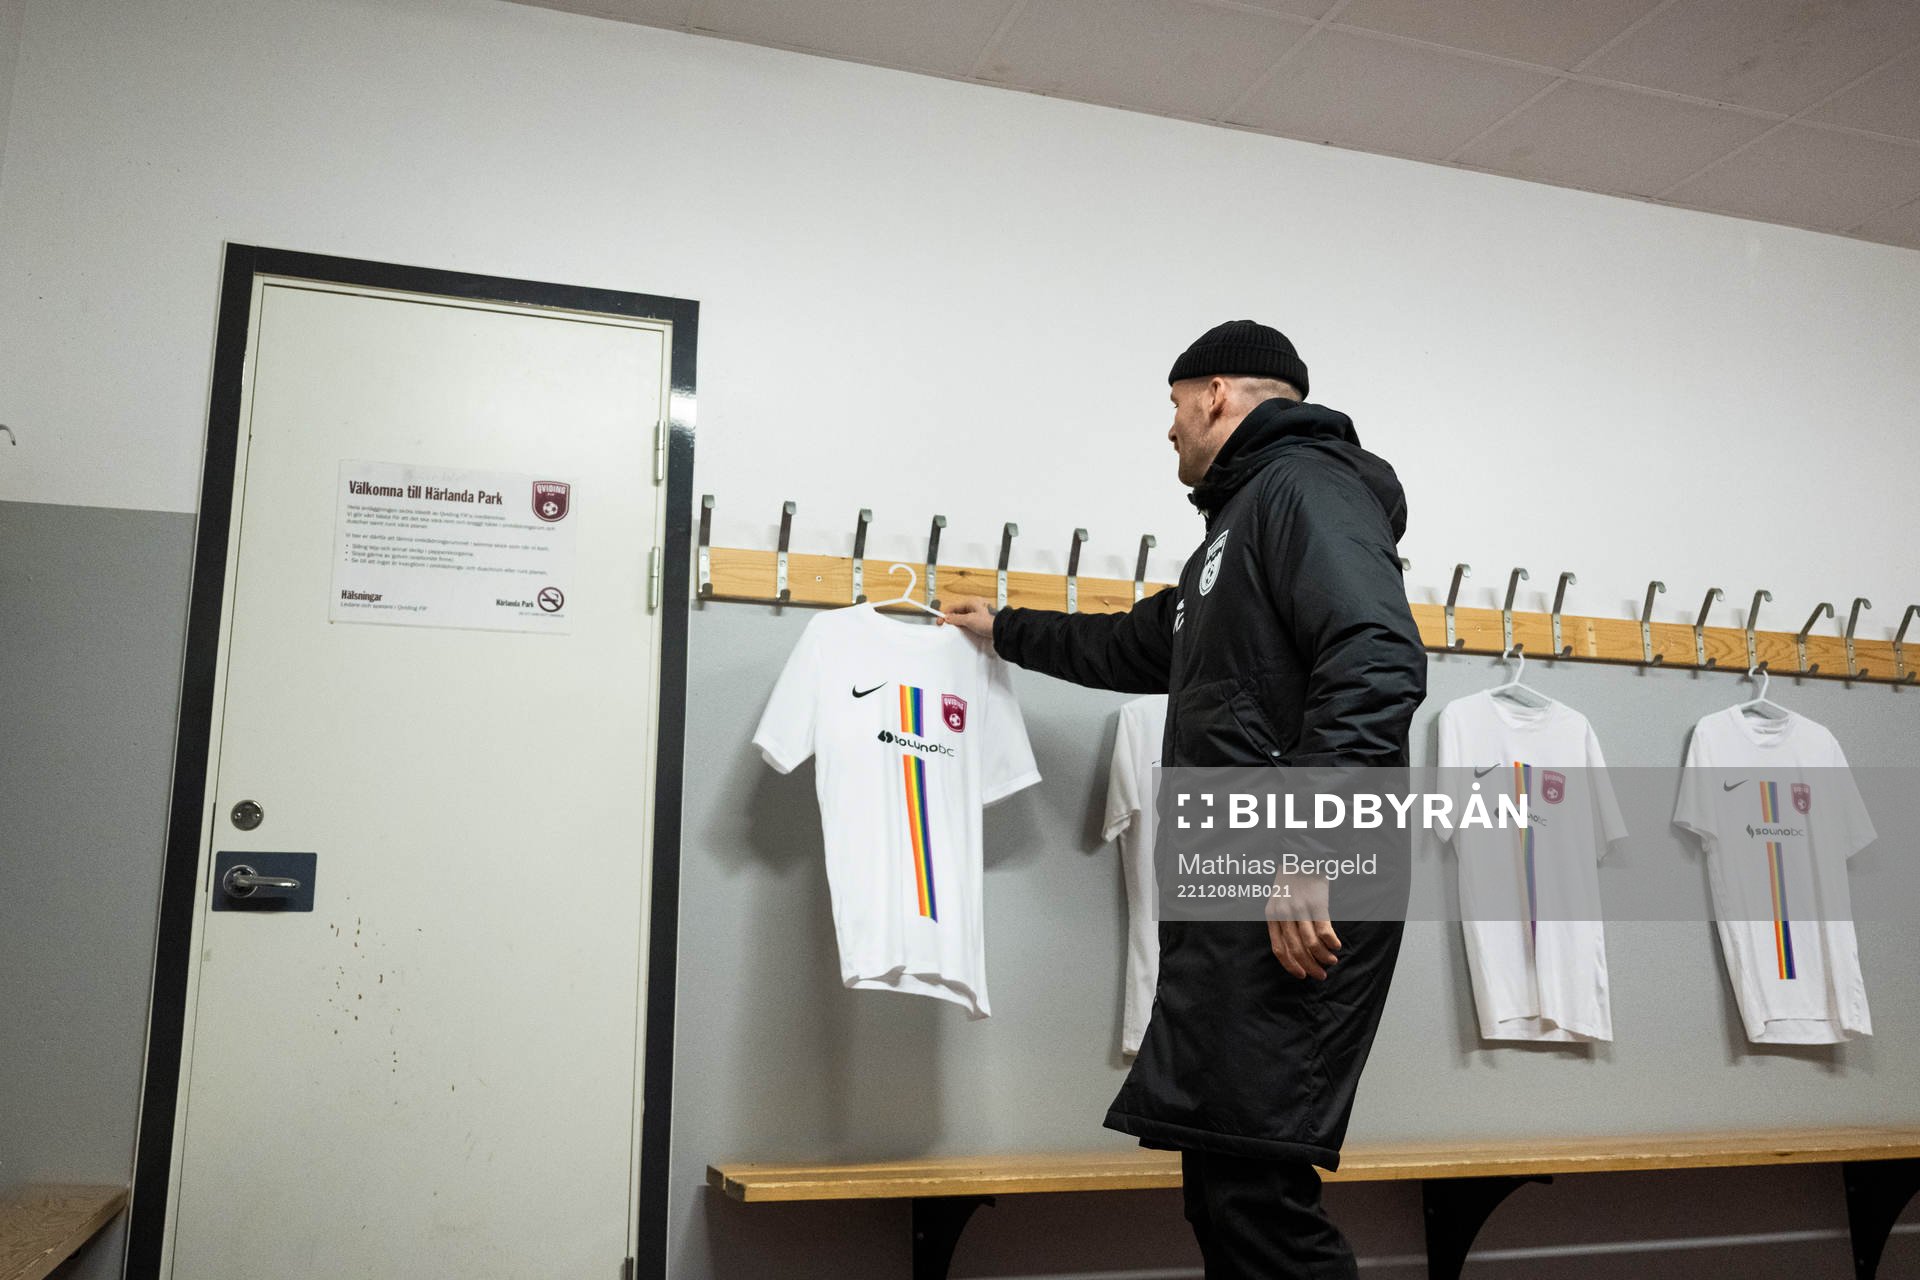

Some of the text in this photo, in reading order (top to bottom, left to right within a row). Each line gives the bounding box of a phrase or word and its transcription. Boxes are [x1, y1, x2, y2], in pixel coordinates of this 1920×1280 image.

[349, 480, 503, 505] Välkomna till Härlanda Park
[341, 589, 383, 603] Hälsningar
[521, 600, 534, 608] Park
